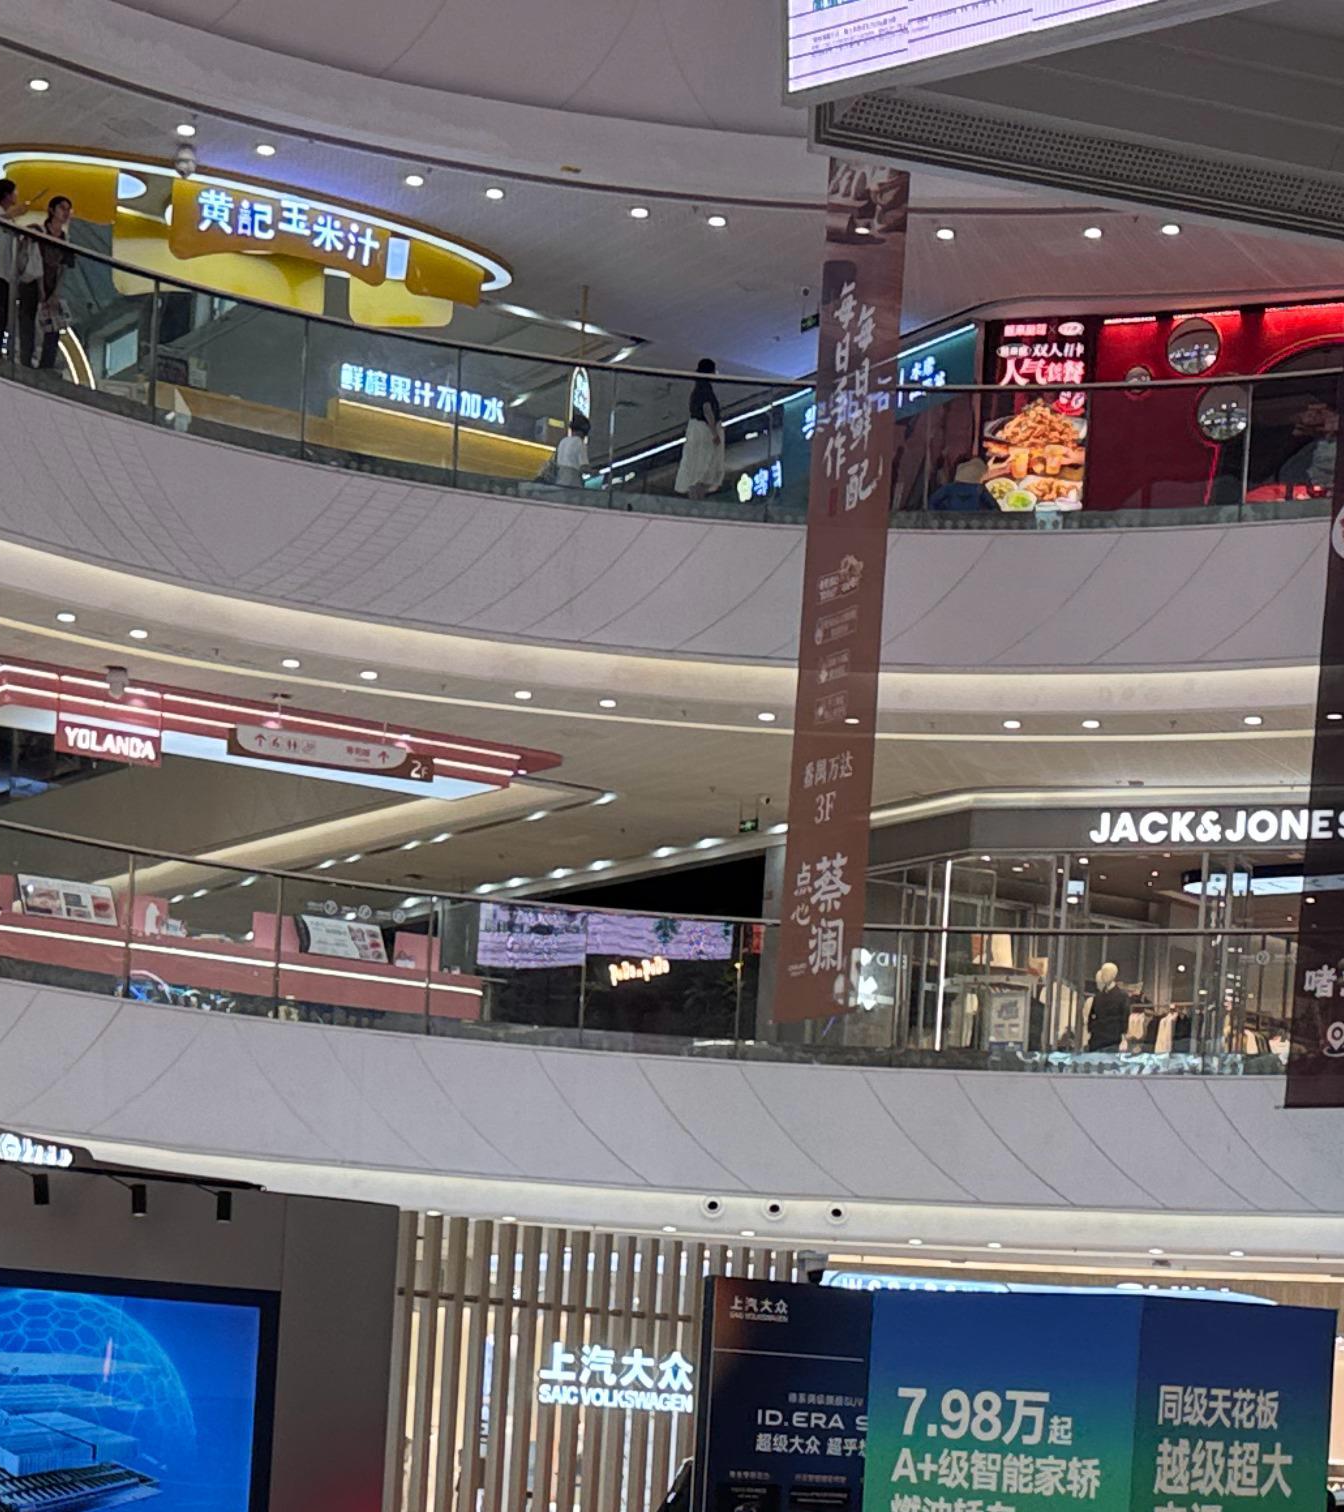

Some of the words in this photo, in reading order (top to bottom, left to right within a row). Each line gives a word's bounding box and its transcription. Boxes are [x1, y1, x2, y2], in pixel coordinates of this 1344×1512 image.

[197, 188, 380, 267] 黄記玉米汁
[339, 362, 506, 425] 鲜榨果汁不加水
[64, 725, 156, 762] YOLANDA
[802, 750, 854, 790] 番禺万达
[814, 791, 837, 824] 3F
[808, 852, 853, 975] 蔡澜
[729, 1295, 789, 1315] 上汽大众
[538, 1341, 694, 1392] 上汽大众
[538, 1383, 581, 1406] SAIC
[580, 1386, 694, 1413] VOLKSWAGEN
[757, 1409, 845, 1430] ID.ERA
[896, 1386, 1074, 1447] 7.98万起
[1158, 1384, 1280, 1430] 同级天花板
[755, 1432, 821, 1456] 超级大众
[890, 1447, 1101, 1500] A+级智能家轿
[1152, 1438, 1294, 1499] 越级超大
